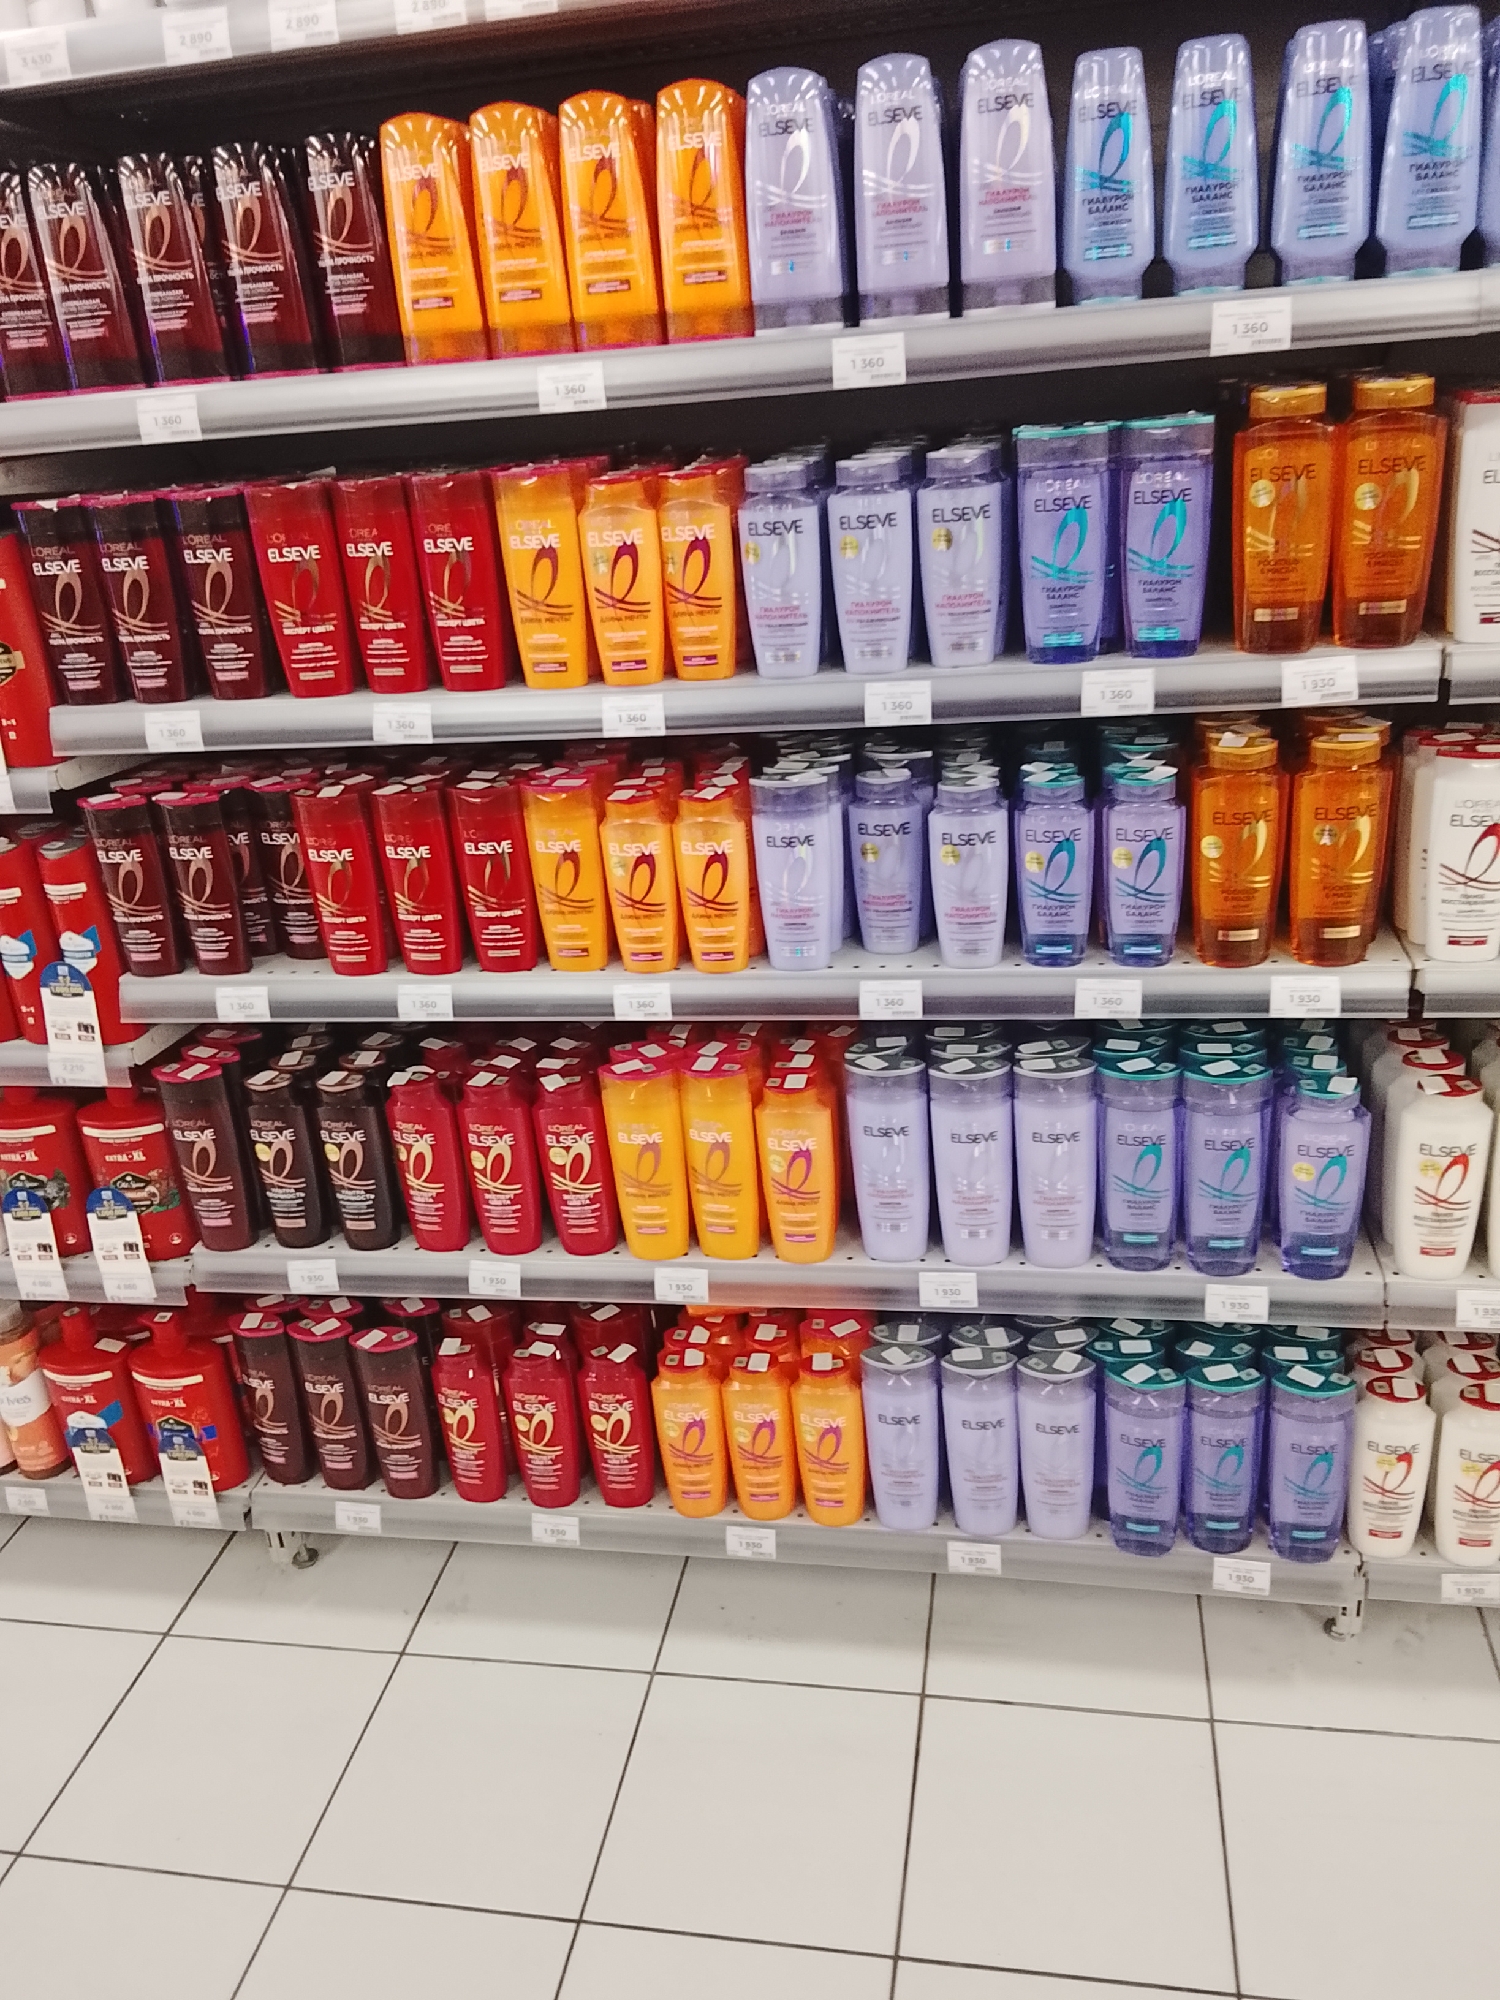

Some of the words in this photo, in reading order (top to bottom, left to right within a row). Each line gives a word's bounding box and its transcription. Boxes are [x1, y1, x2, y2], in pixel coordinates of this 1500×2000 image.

[977, 93, 1034, 113] ELSEVE
[1182, 88, 1242, 109] ELSEVE
[868, 107, 922, 126] ELSEVE
[759, 118, 814, 137] ELSEVE
[569, 143, 621, 163] ELSEVE
[479, 153, 531, 173] ELSEVE
[390, 163, 440, 181] ELSEVE
[1250, 463, 1316, 482] ELSEVE
[1358, 455, 1426, 476] ELSEVE
[1034, 495, 1092, 513] ELSEVE
[1133, 488, 1192, 505] ELSEVE
[839, 512, 898, 530] ELSEVE
[932, 504, 991, 523] ELSEVE
[661, 522, 715, 541] ELSEVE
[748, 519, 803, 537] ELSEVE
[509, 533, 560, 550] ELSEVE
[588, 527, 643, 546] ELSEVE
[347, 542, 392, 558] ELSEVE
[424, 537, 473, 554] ELSEVE
[183, 548, 233, 564] ELSEVE
[268, 546, 320, 563] ELSEVE
[33, 559, 81, 575] ELSEVE
[102, 556, 149, 572] ELSEVE
[1213, 808, 1273, 826] ELSEVE
[1315, 804, 1377, 821] ELSEVE
[857, 821, 911, 837] ELSEVE
[1025, 827, 1081, 843] ELSEVE
[1116, 826, 1173, 841] ELSEVE
[766, 835, 815, 848] ELSEVE
[941, 830, 996, 846] ELSEVE
[169, 846, 213, 861] ELSEVE
[386, 846, 431, 859] ELSEVE
[465, 840, 512, 855] ELSEVE
[535, 840, 582, 853] ELSEVE
[609, 841, 661, 856] ELSEVE
[681, 840, 733, 856] ELSEVE
[99, 848, 143, 863] ELSEVE
[308, 848, 354, 862] ELSEVE
[173, 1129, 216, 1141] ELSEVE
[249, 1129, 295, 1142] ELSEVE
[320, 1130, 366, 1142] ELSEVE
[393, 1131, 436, 1145] ELSEVE
[468, 1132, 515, 1146] ELSEVE
[546, 1132, 594, 1146] ELSEVE
[617, 1131, 663, 1144] ELSEVE
[690, 1128, 732, 1142] ELSEVE
[863, 1125, 910, 1138] ELSEVE
[951, 1131, 999, 1144] ELSEVE
[1031, 1131, 1080, 1144] ELSEVE
[768, 1137, 817, 1152] ELSEVE
[1117, 1134, 1166, 1147] ELSEVE
[1204, 1138, 1254, 1151] ELSEVE
[1298, 1144, 1354, 1158] ELSEVE
[1419, 1143, 1477, 1157] ELSEVE
[305, 1381, 344, 1394] ELSEVE
[368, 1392, 409, 1404] ELSEVE
[438, 1394, 478, 1409] ELSEVE
[512, 1400, 557, 1413] ELSEVE
[589, 1401, 634, 1413] ELSEVE
[664, 1409, 709, 1422] ELSEVE
[734, 1409, 779, 1422] ELSEVE
[800, 1414, 846, 1428] ELSEVE
[878, 1414, 920, 1425] ELSEVE
[962, 1419, 1004, 1430] ELSEVE
[1036, 1423, 1080, 1435] ELSEVE
[1120, 1434, 1166, 1448] ELSEVE
[1368, 1441, 1420, 1455] ELSEVE
[1291, 1443, 1338, 1455] ELSEVE
